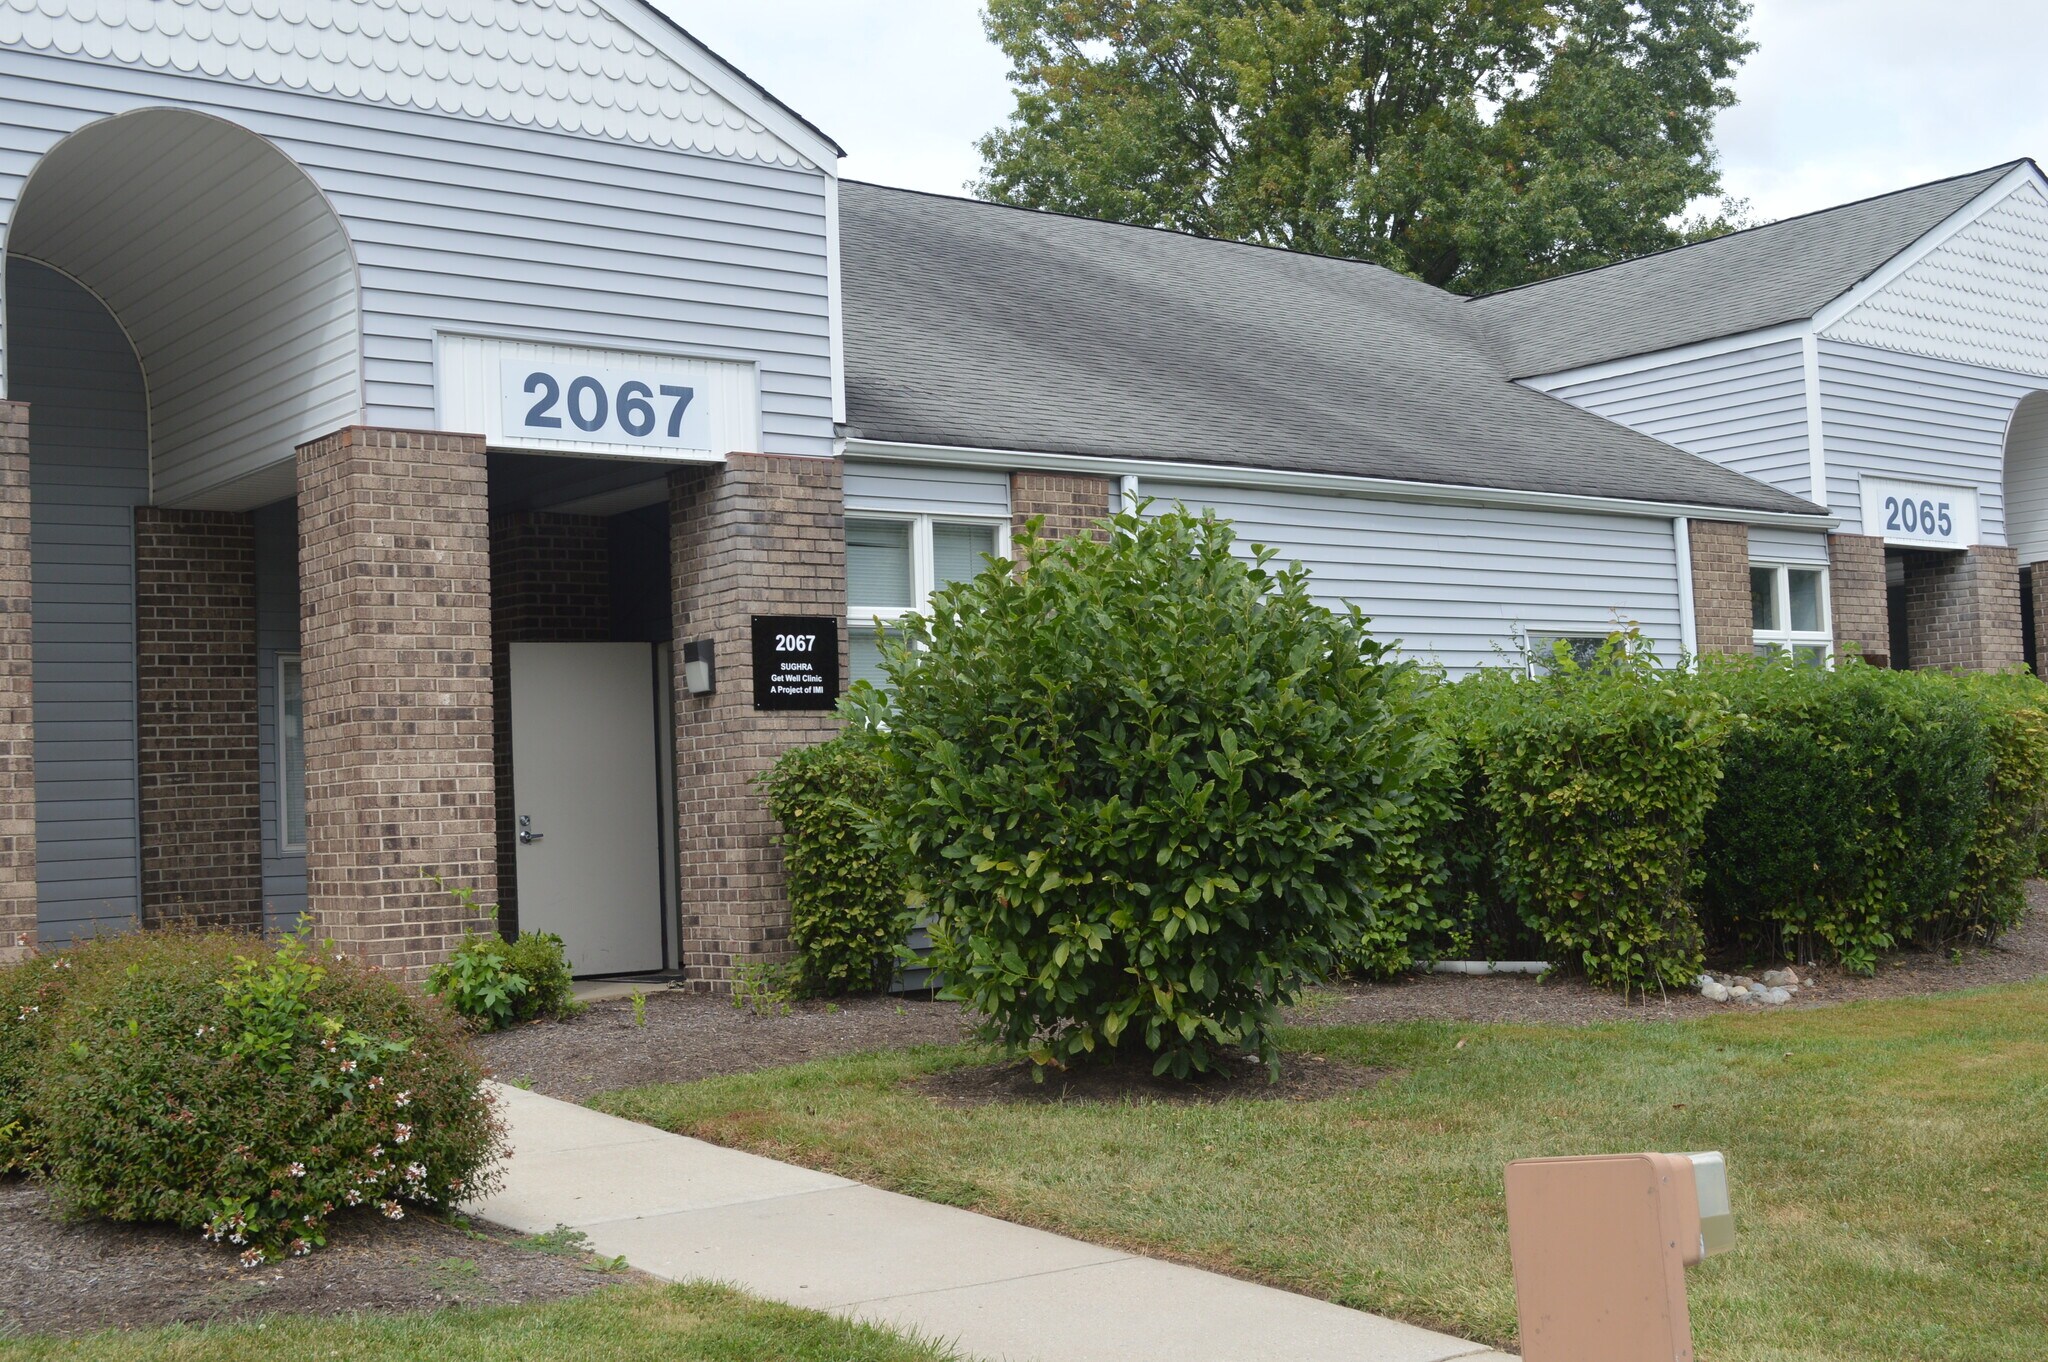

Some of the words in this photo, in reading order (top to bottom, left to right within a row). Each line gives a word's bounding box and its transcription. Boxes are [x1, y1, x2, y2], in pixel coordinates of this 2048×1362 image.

[523, 371, 694, 438] 2067
[1884, 496, 1952, 537] 2065
[775, 634, 816, 652] 2067
[780, 662, 813, 671] SUGHRA
[771, 674, 784, 682] Get
[785, 674, 801, 682] Well
[802, 674, 823, 682] Clinic
[770, 686, 777, 694] A
[777, 686, 803, 695] Project
[804, 686, 812, 694] of
[812, 686, 824, 694] IMI
